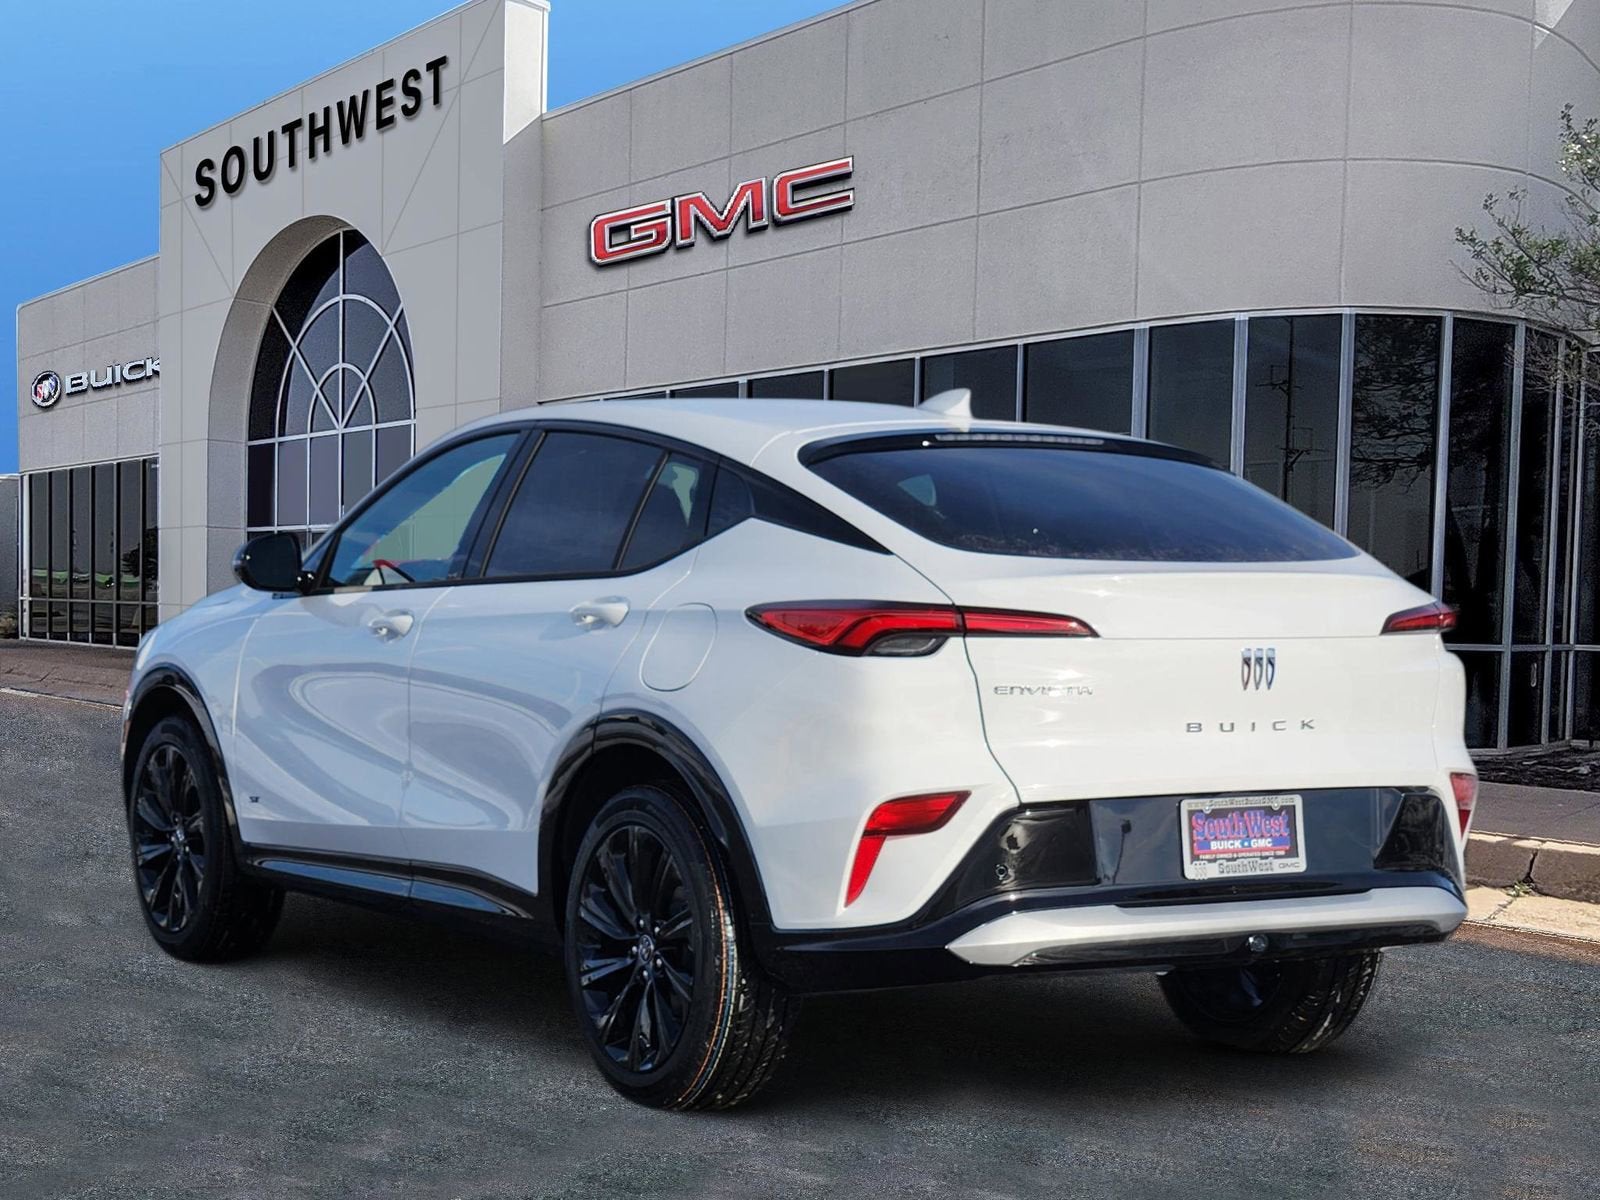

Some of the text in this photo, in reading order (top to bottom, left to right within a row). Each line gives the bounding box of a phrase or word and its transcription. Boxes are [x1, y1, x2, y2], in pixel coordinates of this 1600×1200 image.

[195, 55, 447, 207] SOUTHWEST
[589, 156, 855, 265] GMC
[1186, 719, 1316, 734] BUICK
[1210, 838, 1273, 850] BUICK GMC
[1218, 859, 1300, 874] SouthWest GMC
